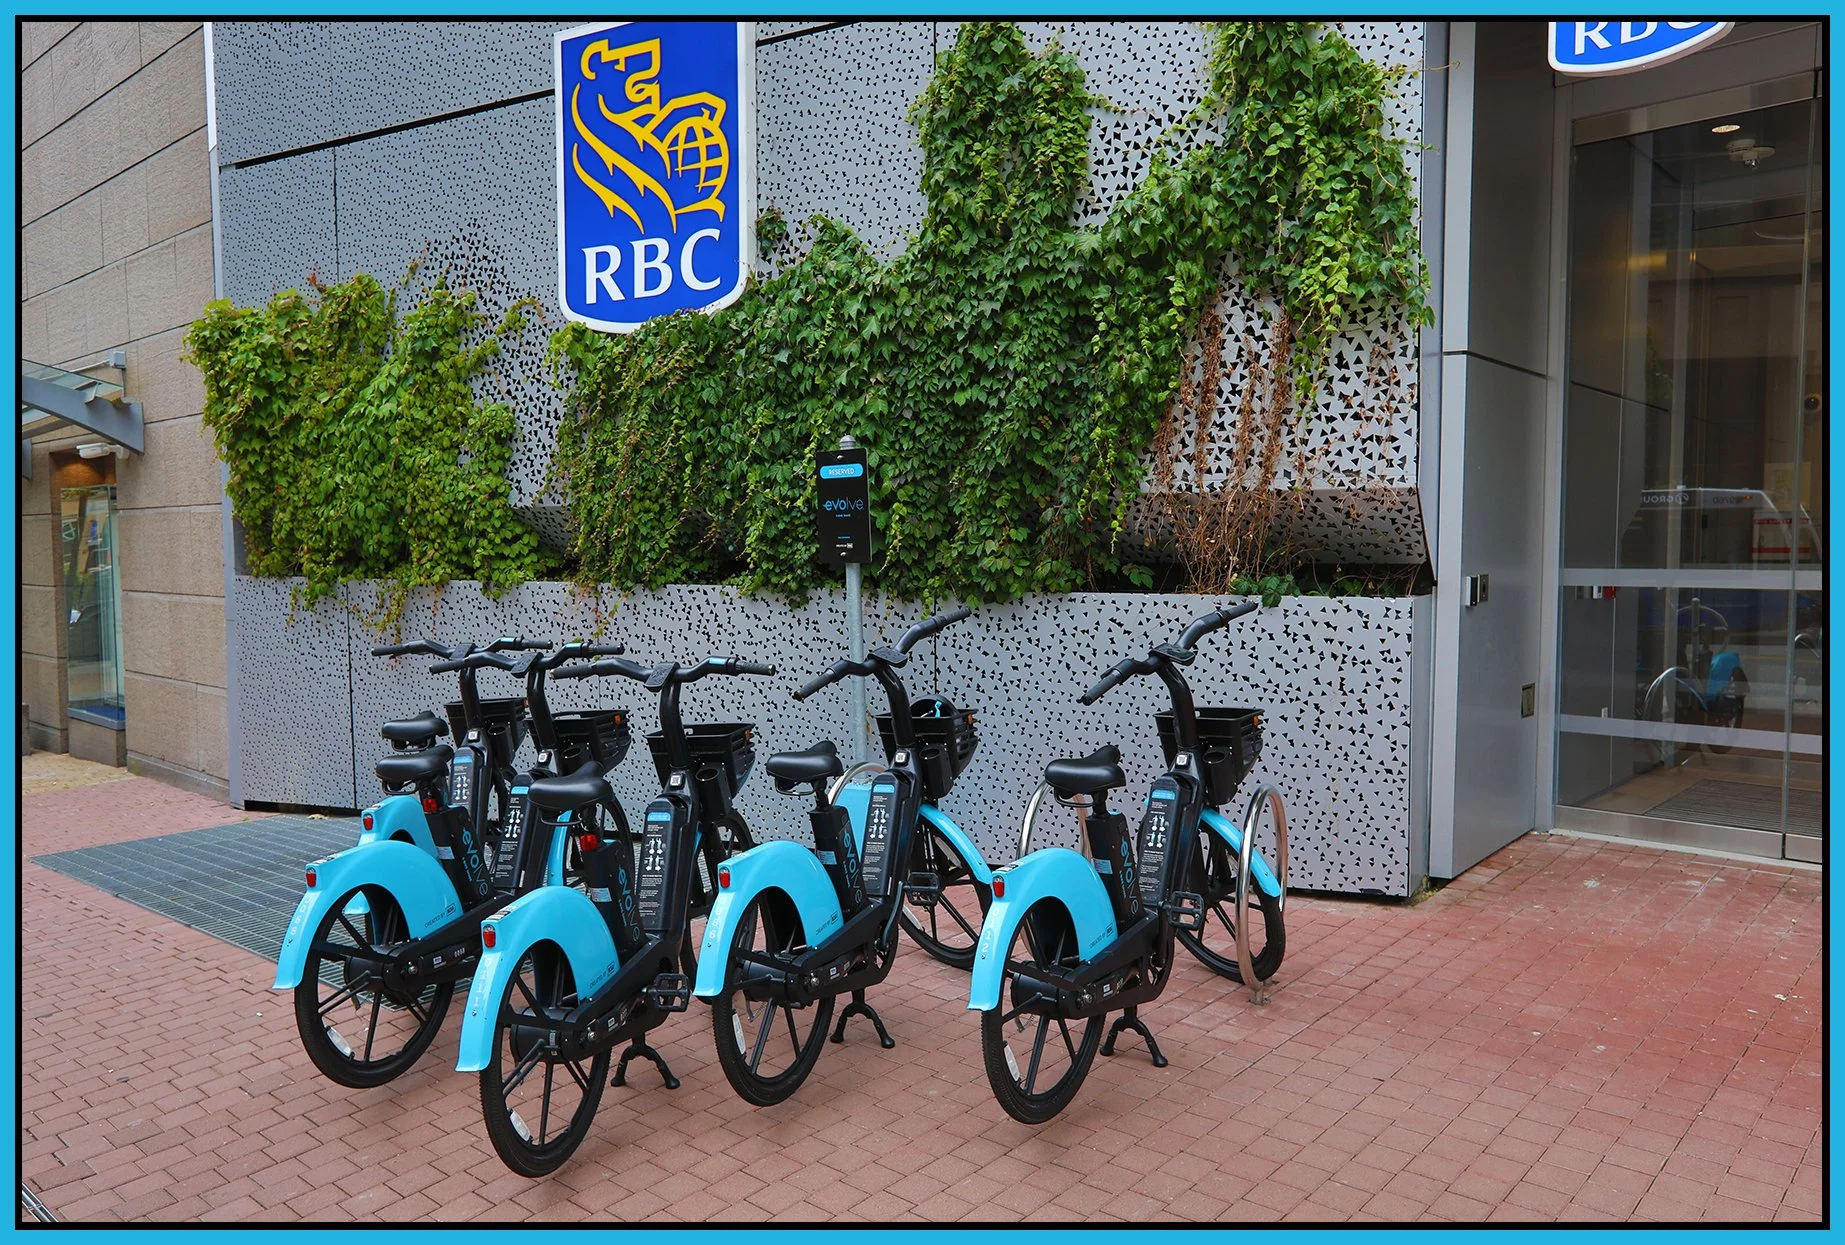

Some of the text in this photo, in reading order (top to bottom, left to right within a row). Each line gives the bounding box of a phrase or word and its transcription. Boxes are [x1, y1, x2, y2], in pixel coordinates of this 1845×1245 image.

[1574, 22, 1703, 56] RB
[581, 228, 721, 305] RBC
[823, 497, 864, 511] evolve
[462, 827, 488, 896] evolve
[843, 828, 862, 904] evolve
[1120, 837, 1139, 914] evolve
[618, 865, 640, 941] evolve
